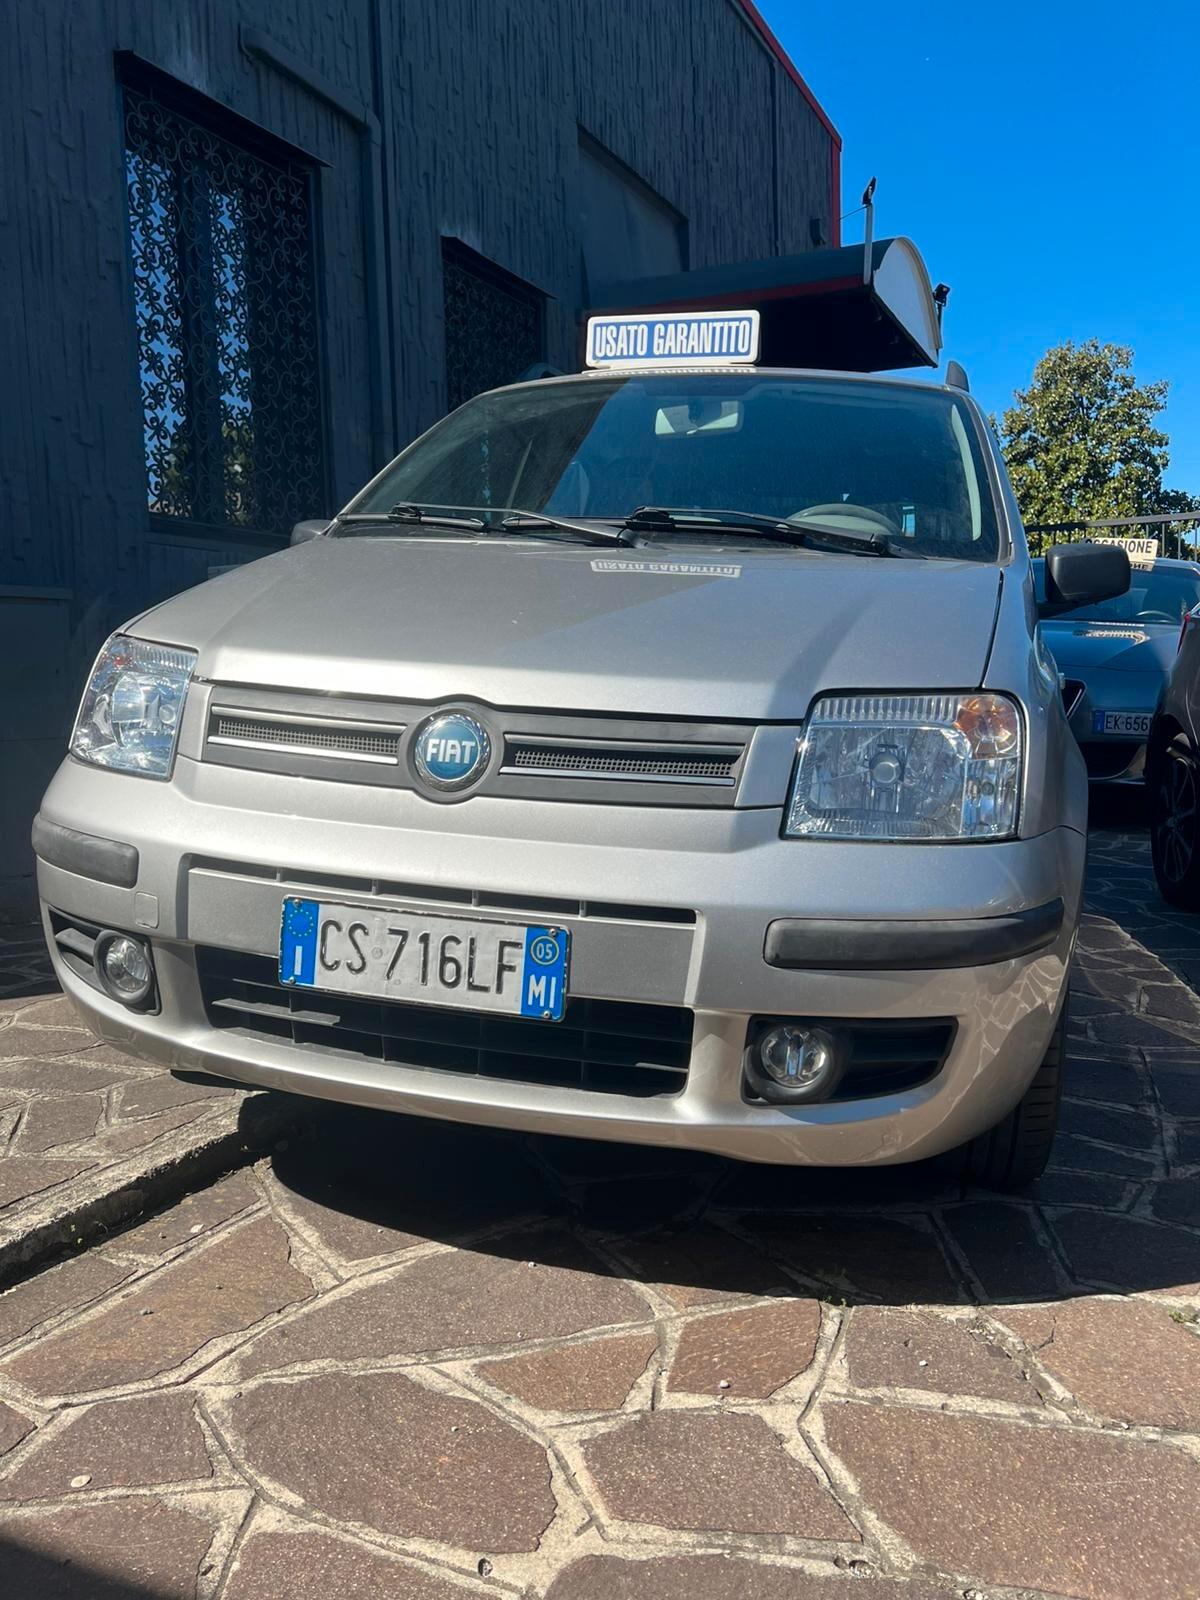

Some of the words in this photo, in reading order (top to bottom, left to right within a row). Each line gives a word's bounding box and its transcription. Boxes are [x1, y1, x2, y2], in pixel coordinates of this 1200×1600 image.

[595, 324, 648, 357] USATO
[653, 320, 750, 355] GARANTITO
[1125, 716, 1152, 731] 656
[426, 738, 476, 764] FIAT
[294, 945, 303, 976] I
[535, 942, 553, 959] 05
[528, 974, 556, 1009] MI
